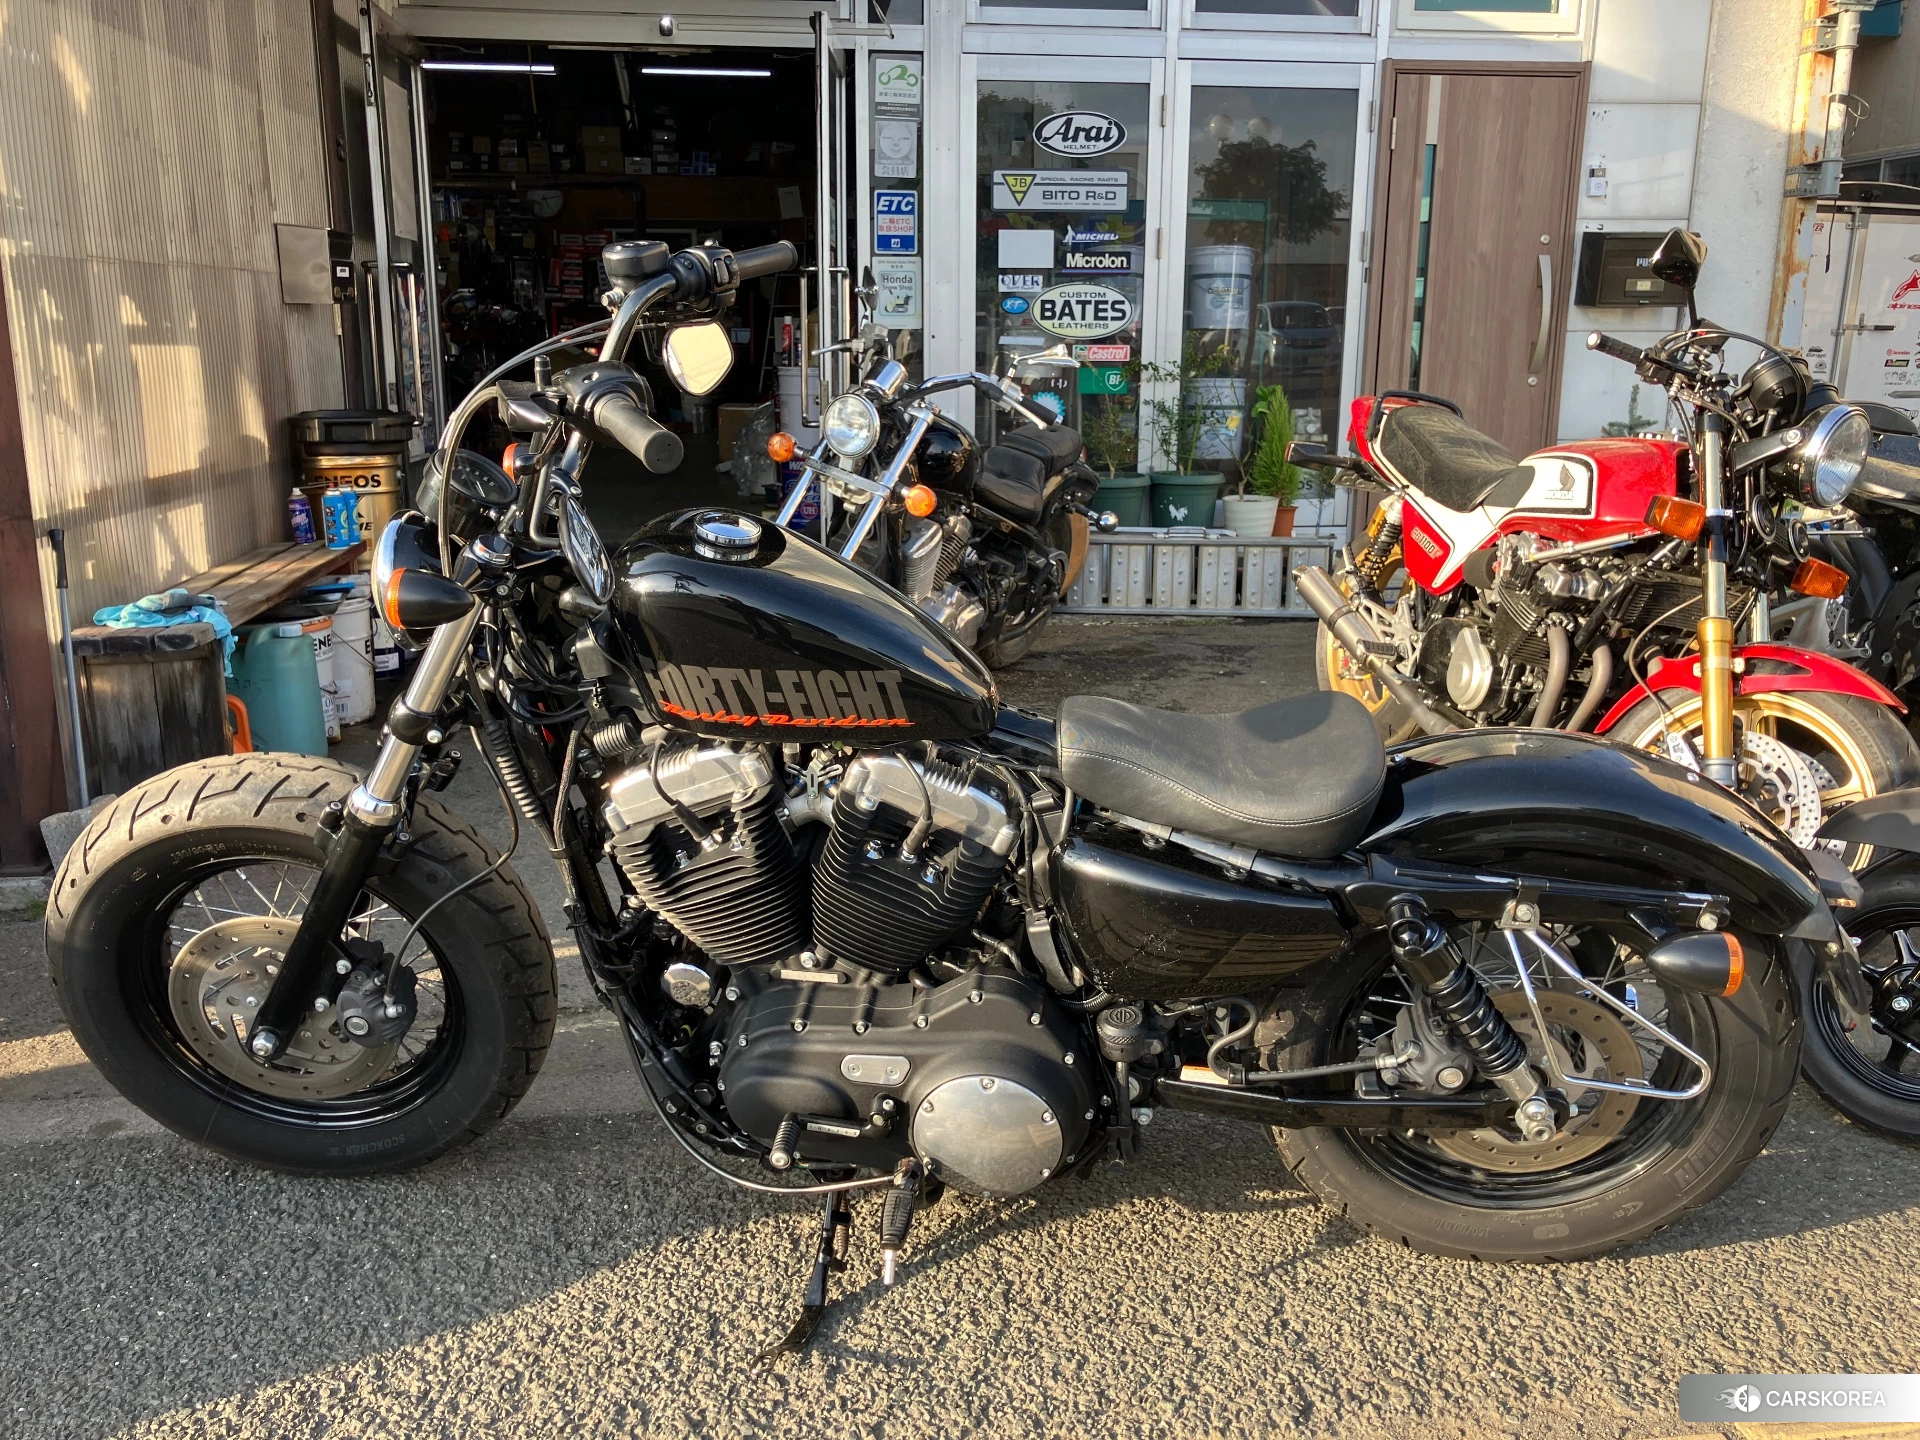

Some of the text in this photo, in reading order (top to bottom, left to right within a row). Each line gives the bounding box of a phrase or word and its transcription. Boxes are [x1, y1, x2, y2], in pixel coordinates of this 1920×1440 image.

[1041, 117, 1115, 143] Arai
[1011, 178, 1027, 188] JB
[1042, 190, 1117, 201] BITO R&D
[877, 196, 914, 212] ETC
[1066, 252, 1128, 268] Microlon
[882, 274, 913, 284] Honda
[1001, 275, 1040, 286] OVER
[1059, 291, 1107, 299] CUSTOM
[1040, 299, 1127, 322] BATES
[1089, 347, 1127, 359] Castrol
[641, 655, 912, 729] FORTY-EIGHT
[659, 699, 915, 727] Harley-Davidson
